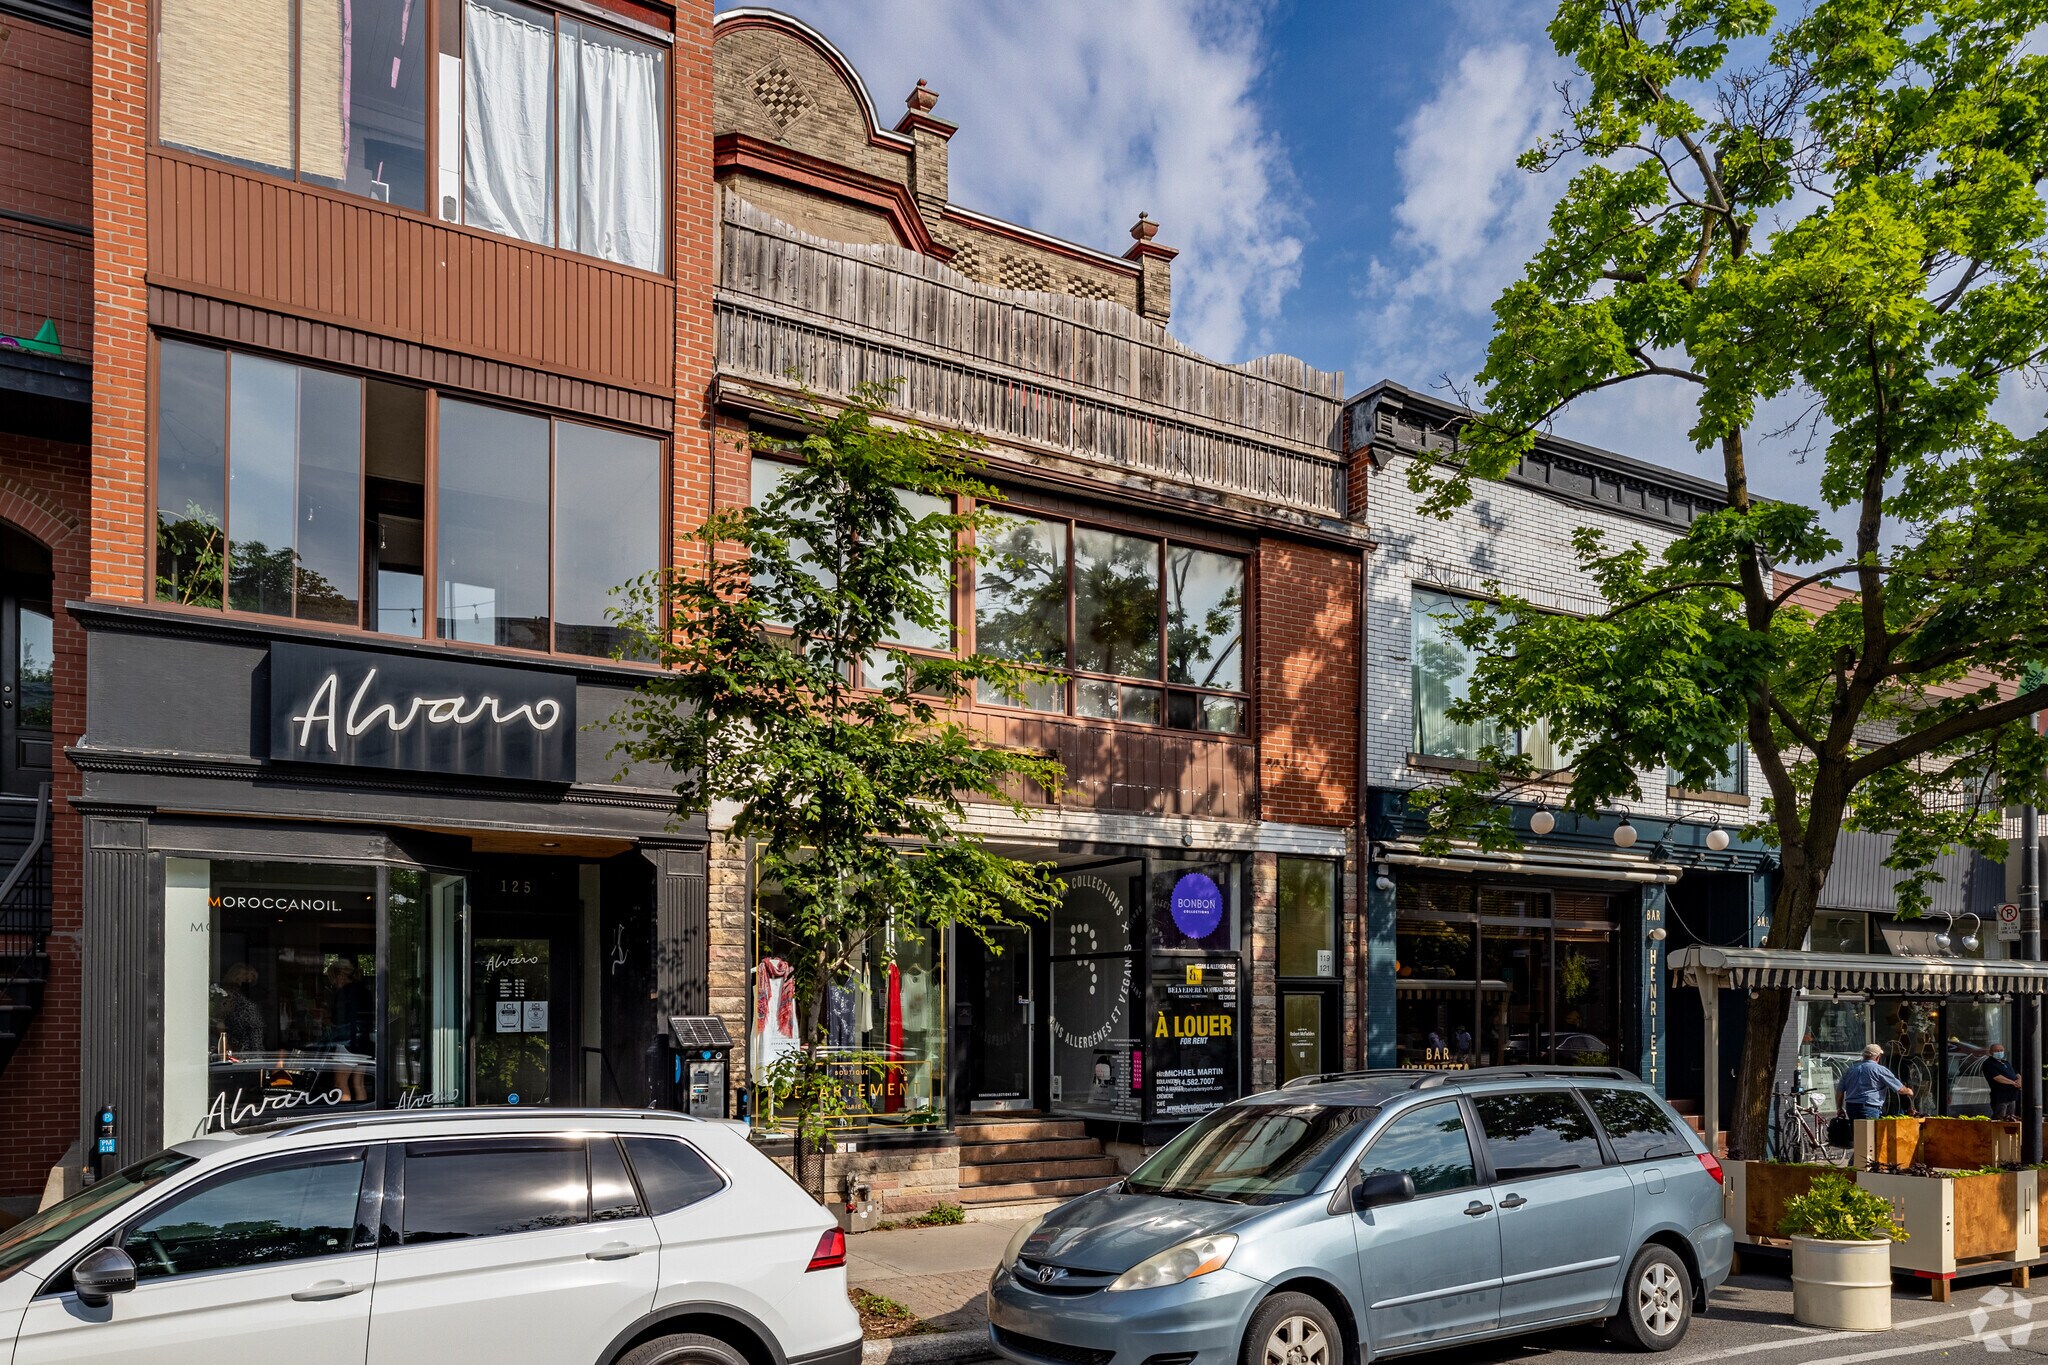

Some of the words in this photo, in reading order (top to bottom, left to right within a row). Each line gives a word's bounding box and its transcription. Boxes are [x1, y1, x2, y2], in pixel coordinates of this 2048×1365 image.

[292, 668, 560, 751] Alvaro
[500, 880, 531, 893] 125
[1072, 875, 1124, 916] COLLECTIONS
[1178, 899, 1216, 909] BONBON
[1646, 909, 1661, 921] BAR
[485, 954, 538, 971] Alvaro
[1065, 1021, 1112, 1048] ALLERGÈNES
[1111, 1006, 1121, 1023] ET
[1155, 1010, 1169, 1037] À
[1174, 1015, 1232, 1037] LOUER
[1650, 949, 1658, 1089] HENRIETT
[1180, 1037, 1192, 1045] FOR
[1426, 1047, 1449, 1060] BAR
[1165, 1069, 1196, 1077] MICHAEL
[1197, 1068, 1223, 1076] MARTIN
[203, 1088, 343, 1130] Alvaro
